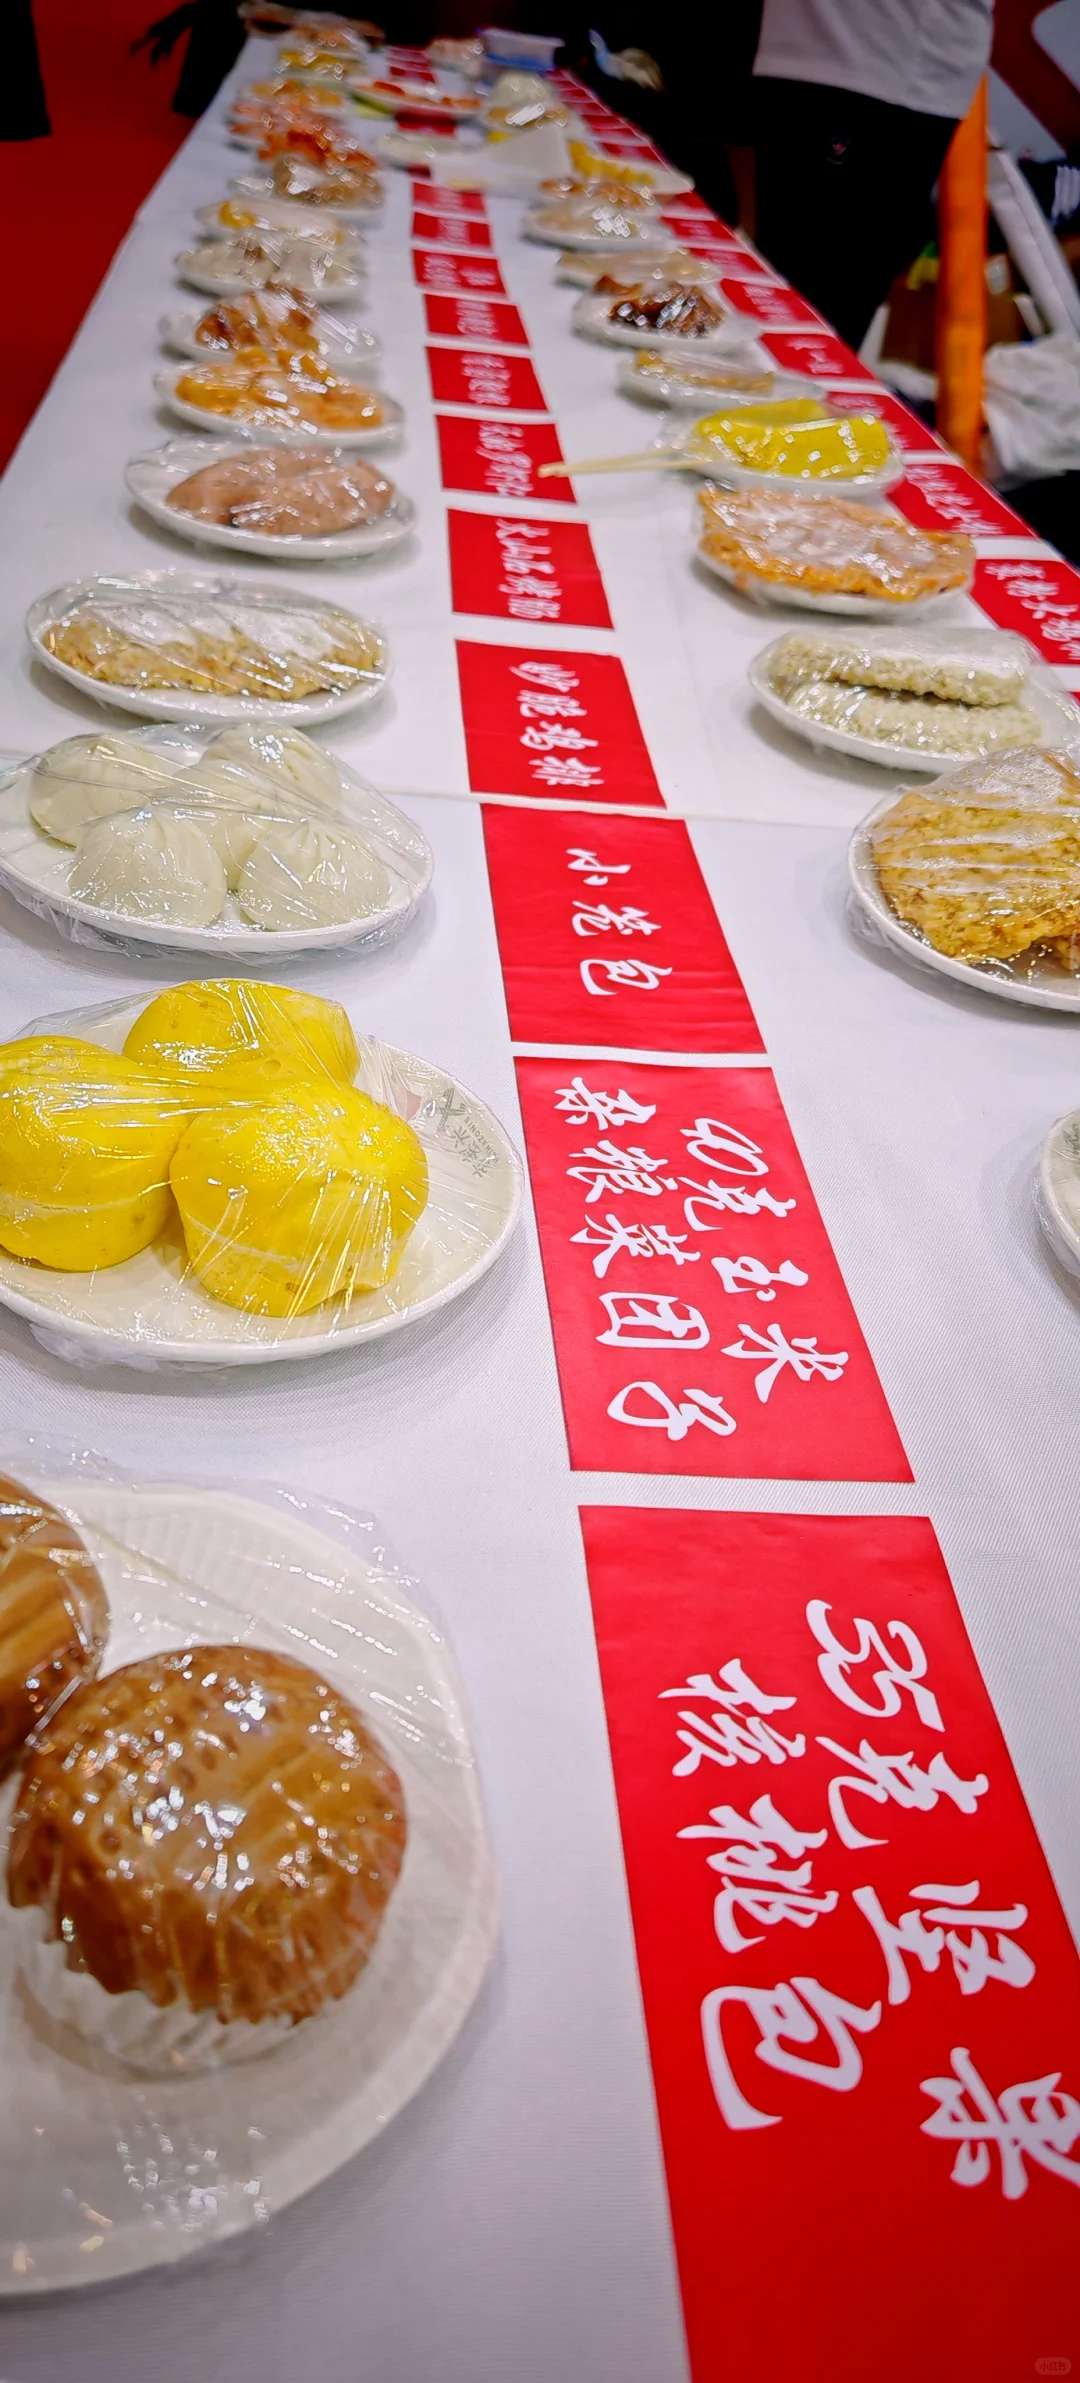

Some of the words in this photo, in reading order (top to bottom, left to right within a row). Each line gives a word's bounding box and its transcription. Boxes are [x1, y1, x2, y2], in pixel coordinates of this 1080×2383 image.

[495, 518, 563, 619] 火山石烤肠
[509, 661, 605, 788] 妙脆鸡排
[565, 848, 673, 996] 小笼包
[553, 1077, 737, 1441] 杂粮菜团子
[680, 1118, 849, 1403] 40克玉米
[658, 1659, 884, 2130] 核桃包
[806, 1600, 1080, 2199] 35克坚果
